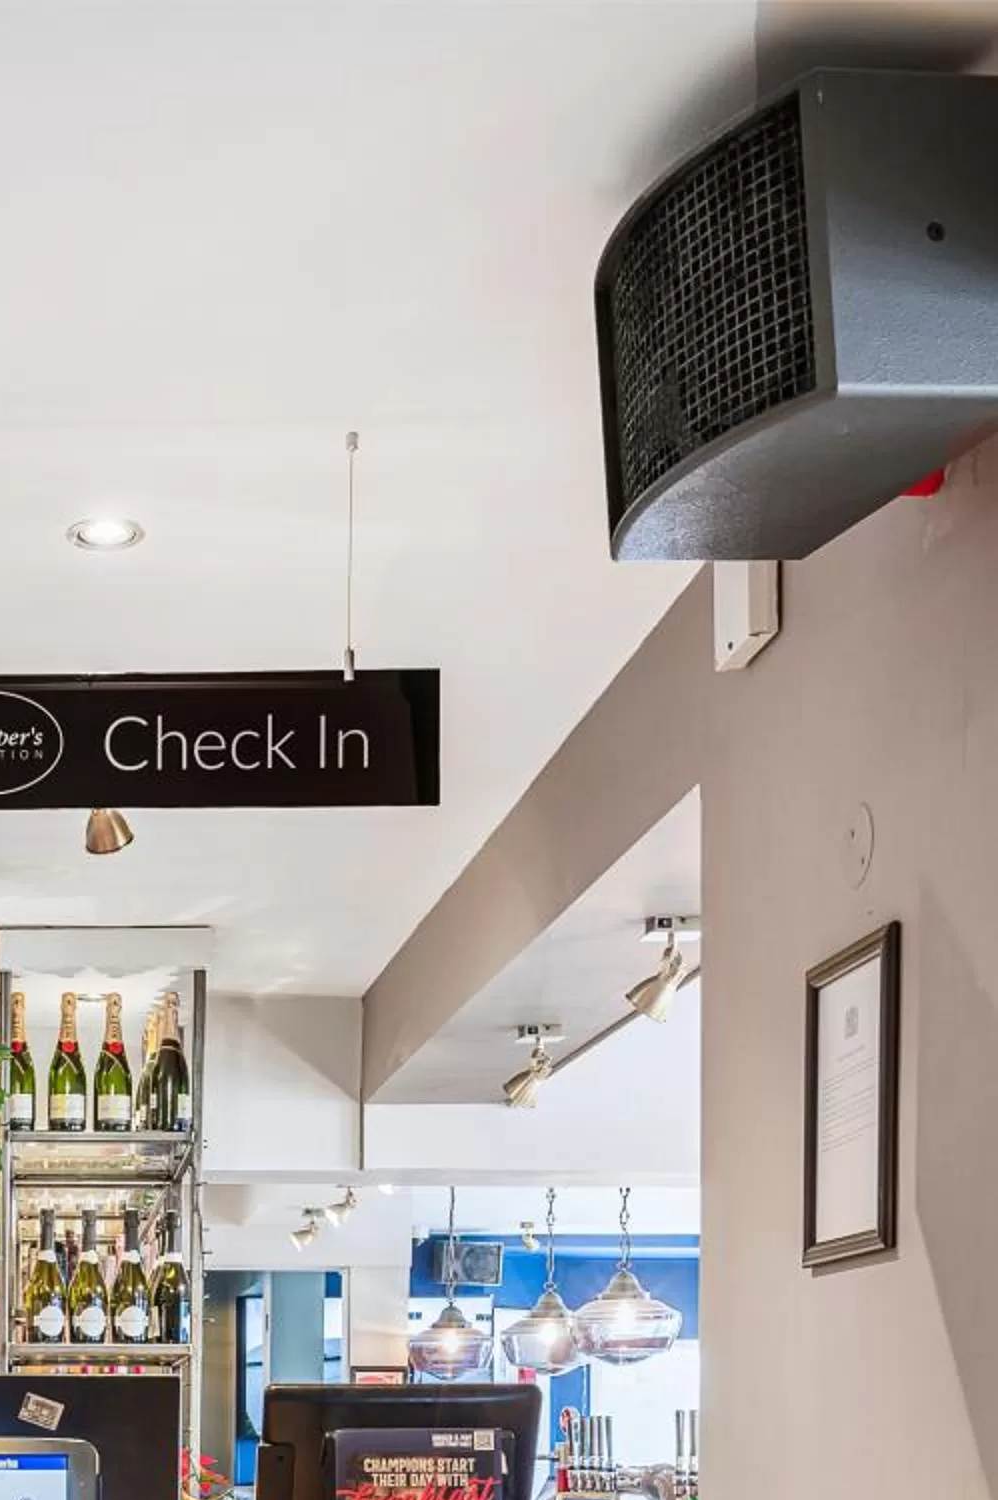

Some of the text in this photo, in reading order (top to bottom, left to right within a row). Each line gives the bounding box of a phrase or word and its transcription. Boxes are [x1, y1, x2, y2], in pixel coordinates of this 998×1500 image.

[104, 714, 370, 771] Check In
[363, 1457, 476, 1473] CHAMPIONS START
[372, 1473, 468, 1487] THEIR DAY WITH
